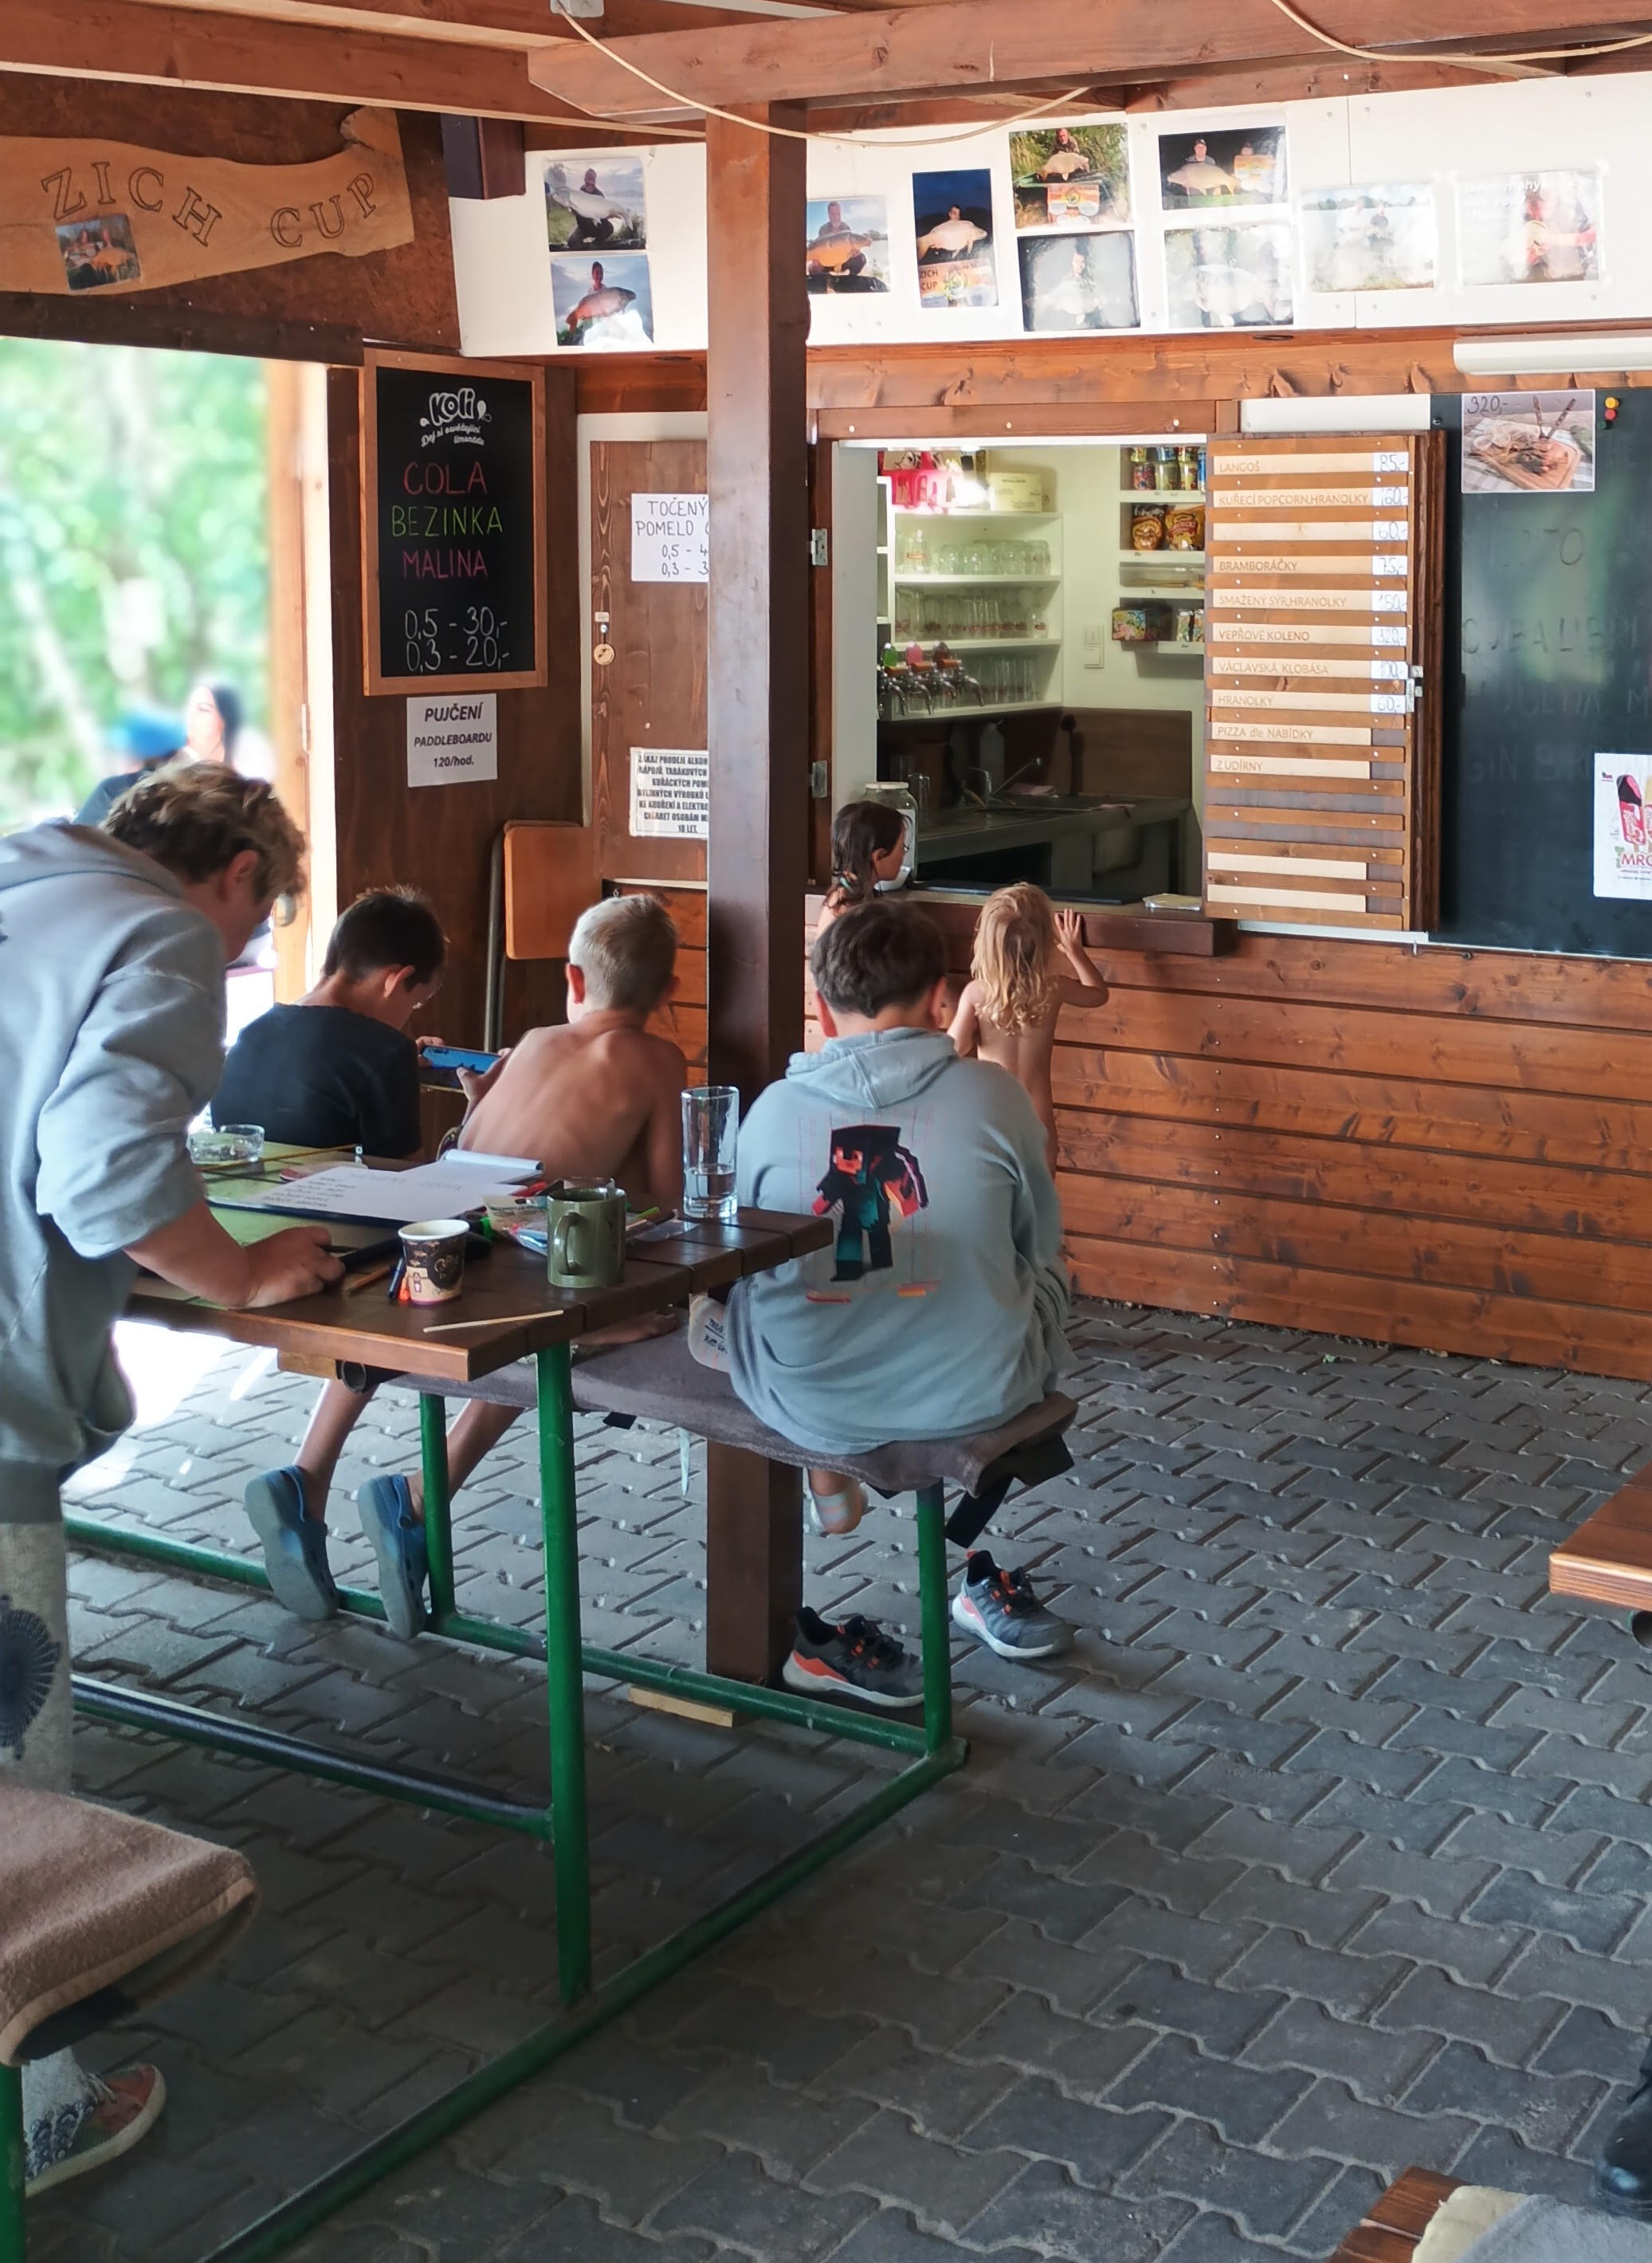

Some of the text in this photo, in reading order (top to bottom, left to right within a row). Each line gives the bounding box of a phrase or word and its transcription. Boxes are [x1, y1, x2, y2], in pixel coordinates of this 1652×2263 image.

[41, 161, 375, 248] ZICH CUP
[1467, 395, 1508, 414] 320,-
[1219, 454, 1405, 473] LANGOŠ 85,-
[403, 462, 488, 495] COLA
[647, 497, 708, 517] TOČENÝ
[1219, 493, 1256, 506] KUŘECÍ
[391, 505, 503, 536] BEZINKA
[635, 520, 694, 536] POMELO
[661, 544, 679, 560] 0,5
[402, 548, 488, 579] MALINA
[661, 562, 679, 577] 0,3
[1219, 559, 1297, 572] BRAMBORÁČKY
[1219, 594, 1267, 606] SMAŽENÝ
[405, 608, 438, 639] 0,5
[462, 606, 508, 637] 30,-
[1219, 628, 1265, 641] VEPŘOVÉ
[1267, 631, 1310, 641] KOLENO
[406, 638, 441, 673] 0,3
[465, 636, 510, 669] 20,-
[1219, 660, 1278, 673] VÁCLAVSKÁ
[1281, 662, 1328, 674] KLOBÁSA
[1218, 694, 1273, 706] HRANOLKY
[414, 732, 492, 747] PADDLEBOARDU
[1218, 726, 1313, 740] PIZZA dle NABÍDKY
[434, 754, 474, 767] 120/hod.
[638, 755, 658, 764] ZKAZ
[1224, 759, 1263, 772] UDÍRNY
